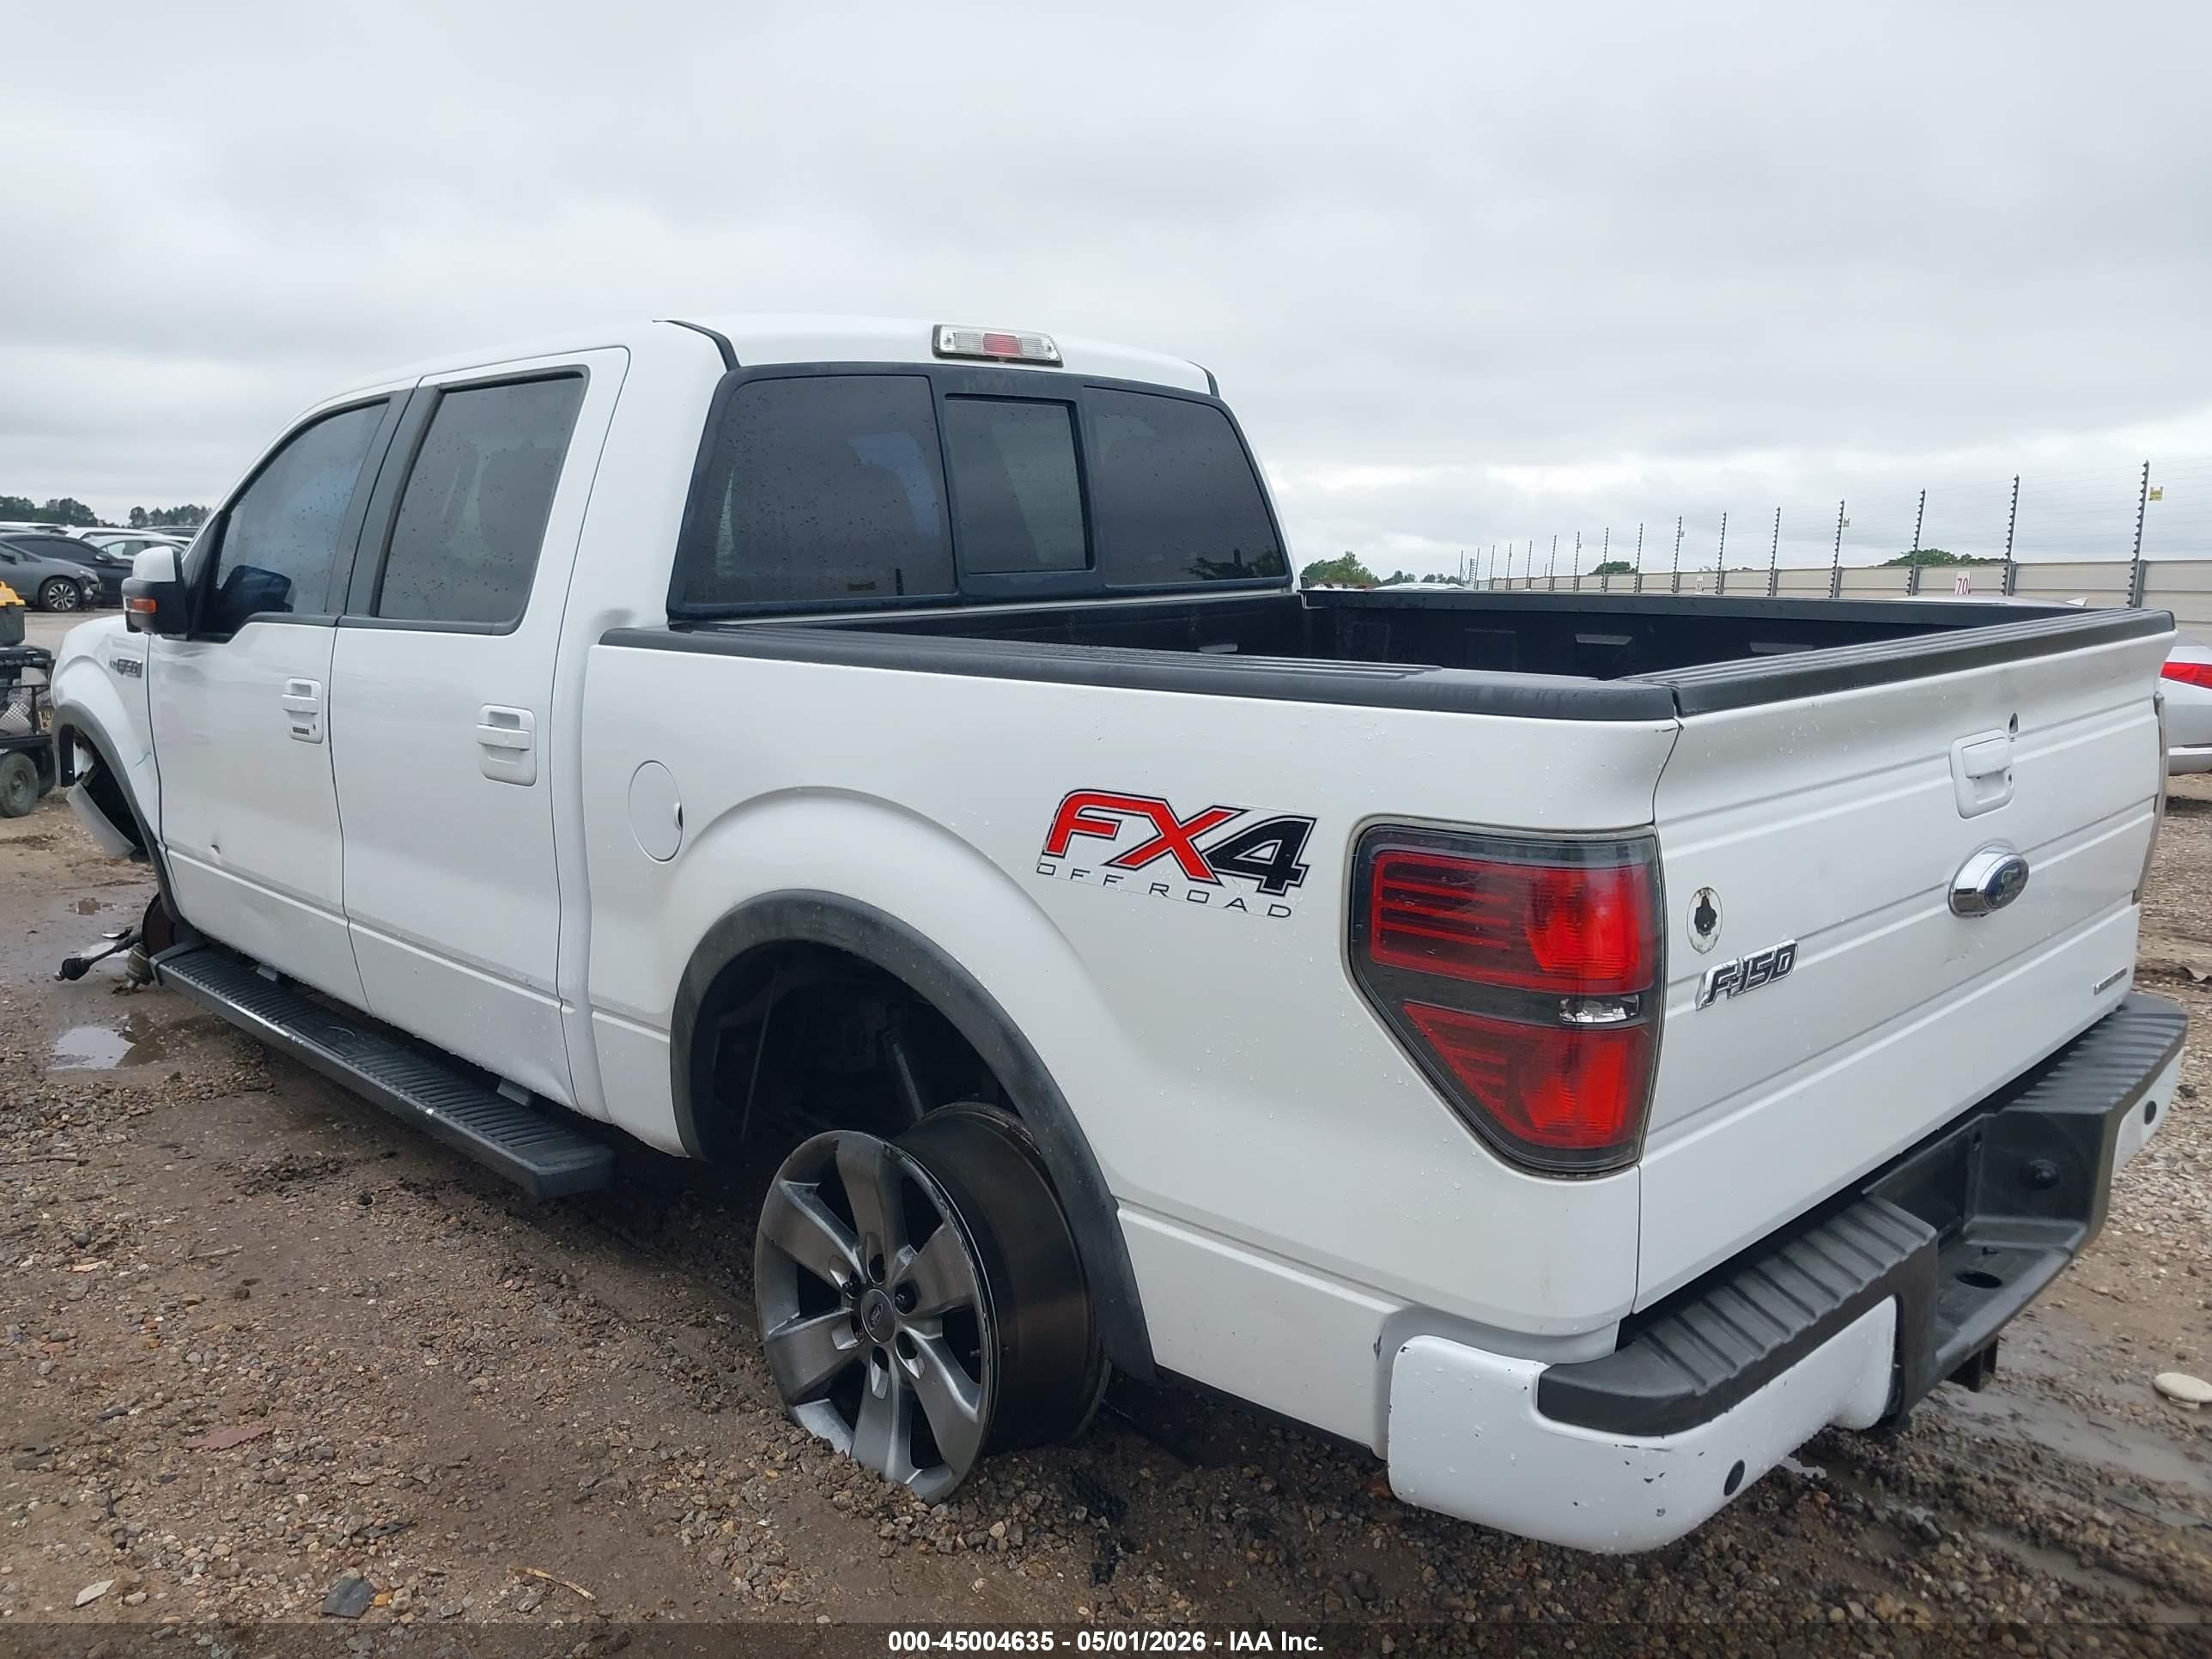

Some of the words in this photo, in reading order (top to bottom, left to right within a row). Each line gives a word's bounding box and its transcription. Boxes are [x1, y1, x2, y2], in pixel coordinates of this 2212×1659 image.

[1042, 788, 1317, 897] FX4
[1036, 862, 1125, 887] OFF
[1148, 882, 1292, 919] ROAD
